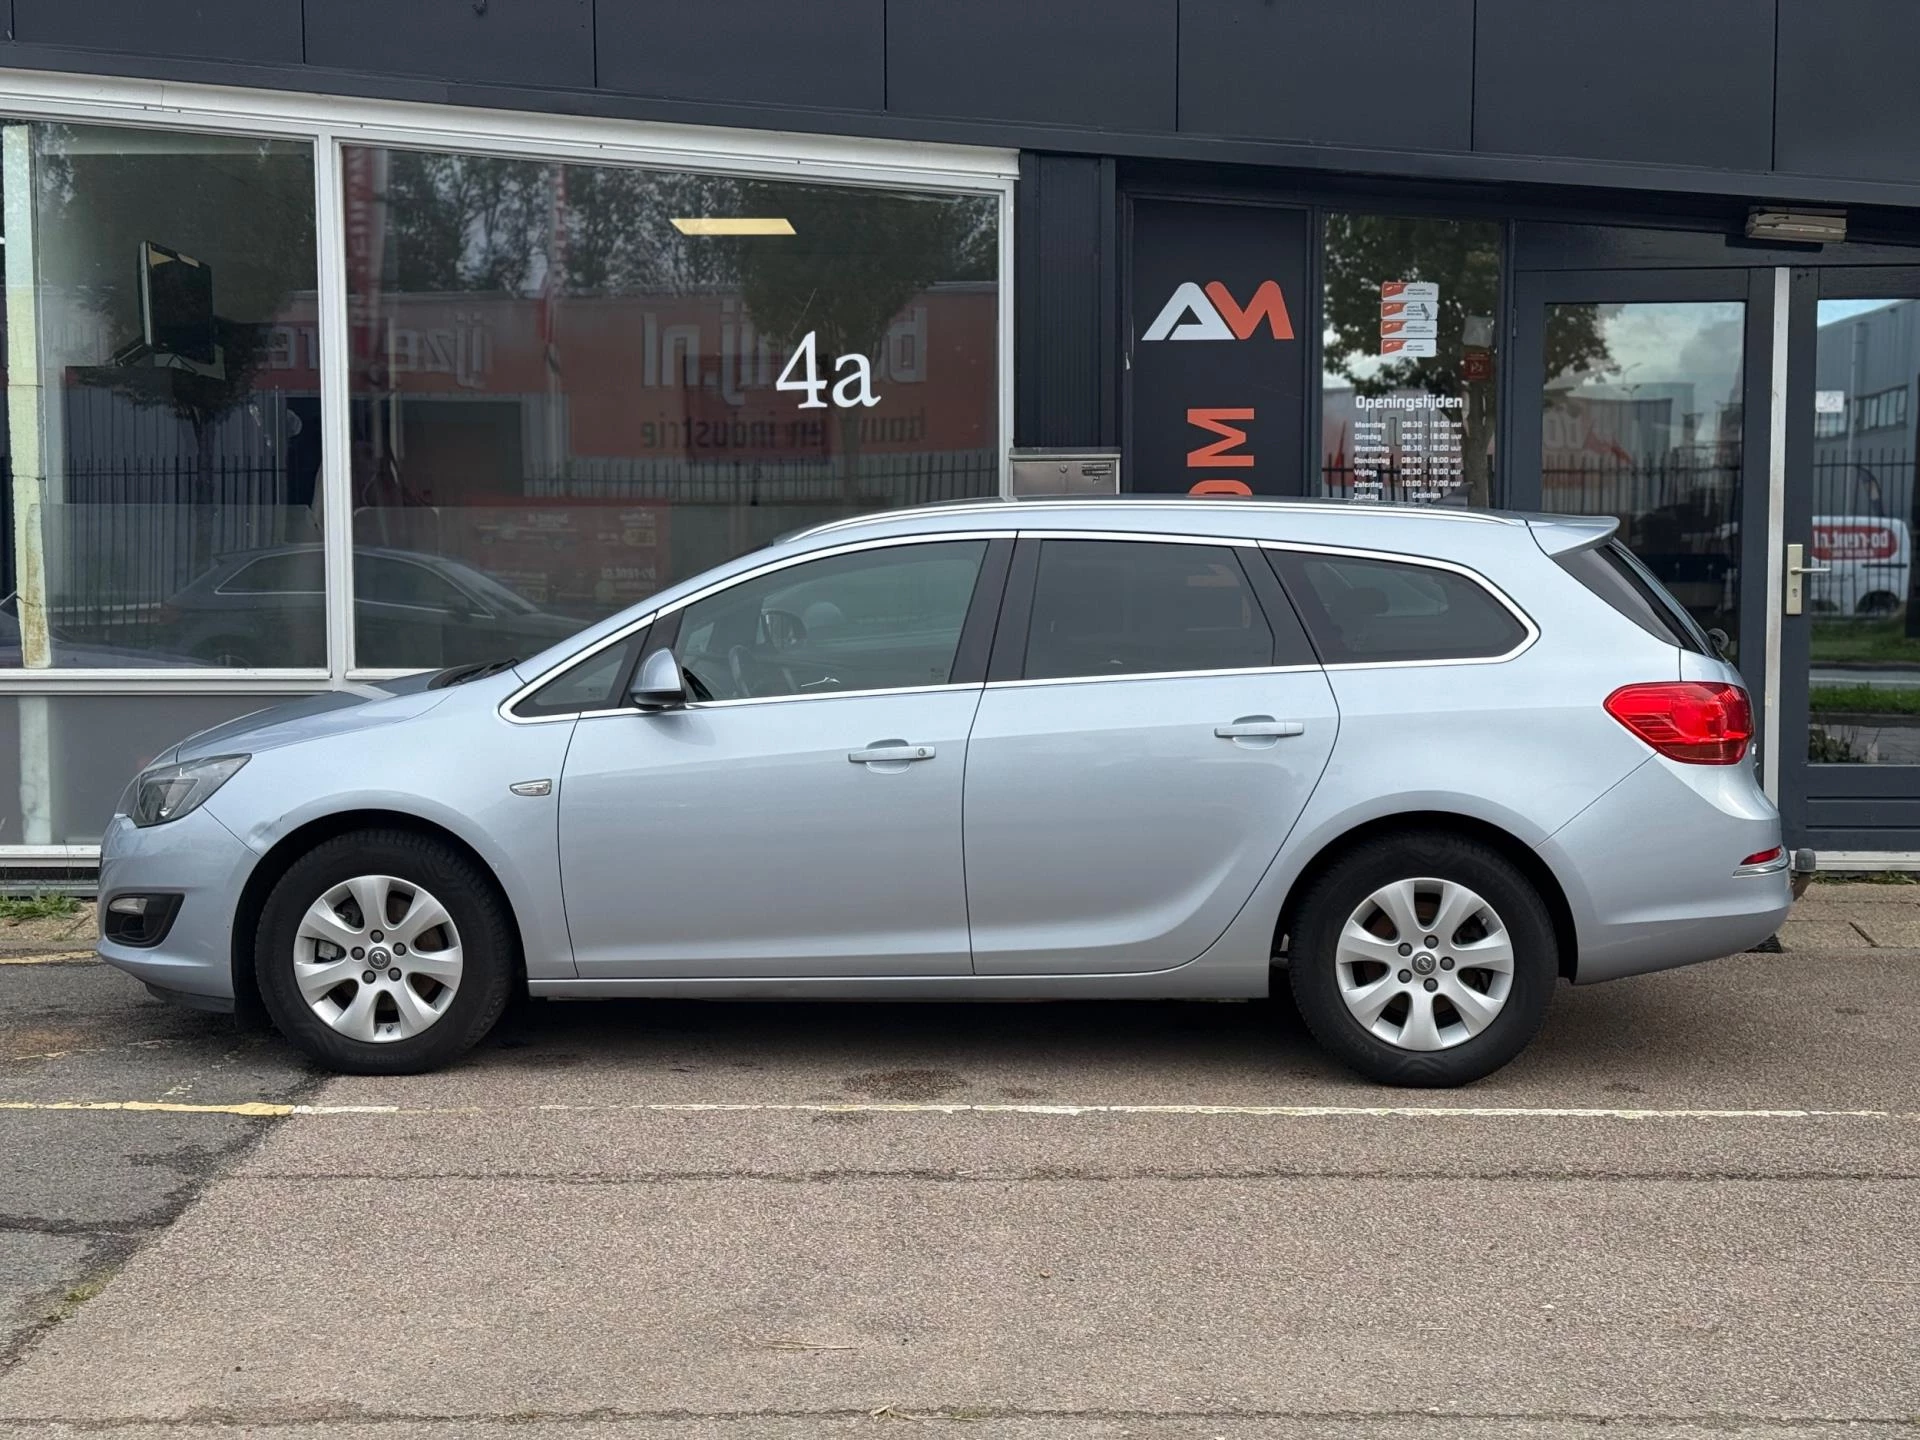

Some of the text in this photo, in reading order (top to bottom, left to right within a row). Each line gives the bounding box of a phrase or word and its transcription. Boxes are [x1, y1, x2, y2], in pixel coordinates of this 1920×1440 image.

[1141, 280, 1294, 341] AM
[775, 330, 882, 409] 4a
[1355, 395, 1463, 411] Openingstijden
[1353, 492, 1379, 501] Zondag
